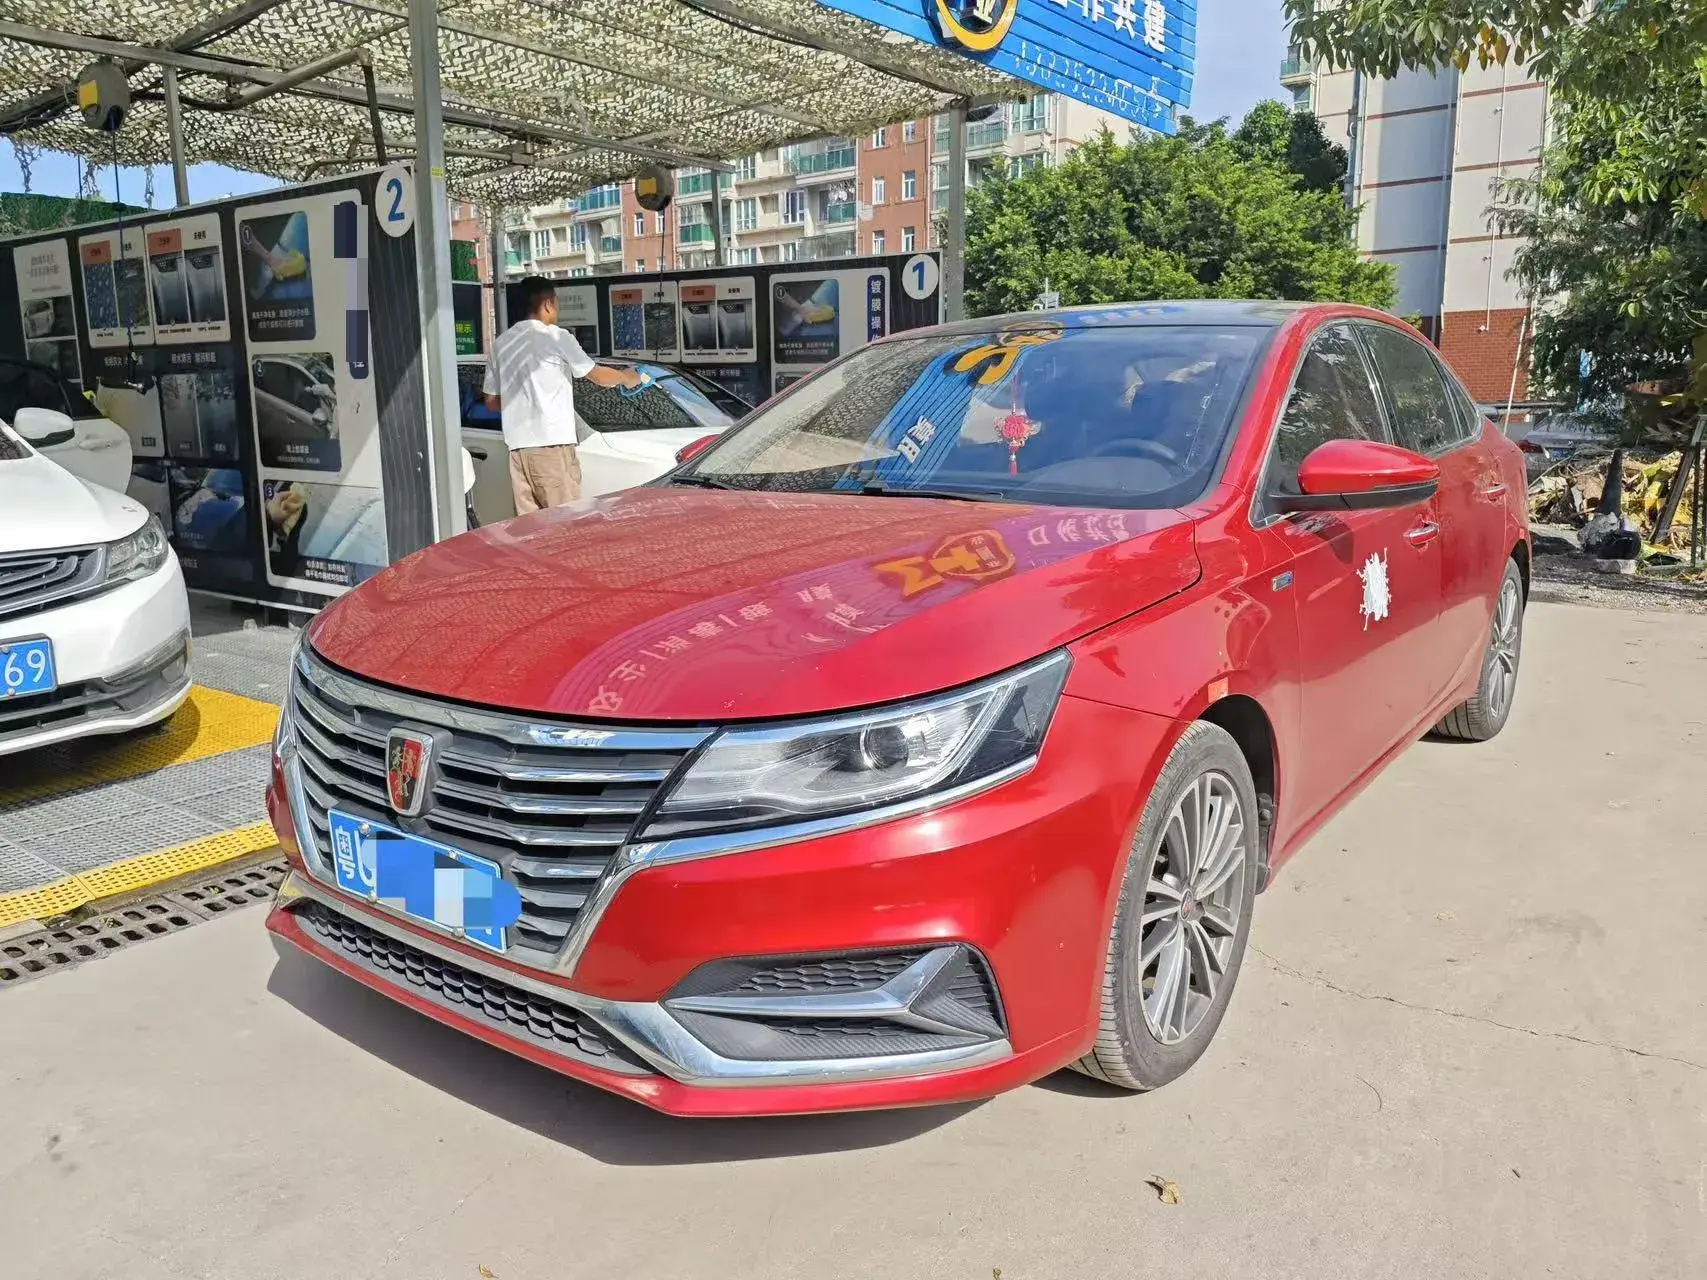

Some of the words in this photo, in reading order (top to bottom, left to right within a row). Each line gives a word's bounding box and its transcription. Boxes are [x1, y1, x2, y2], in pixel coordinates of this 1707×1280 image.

[386, 178, 405, 221] 2
[912, 261, 925, 291] 1
[4, 648, 47, 687] 69
